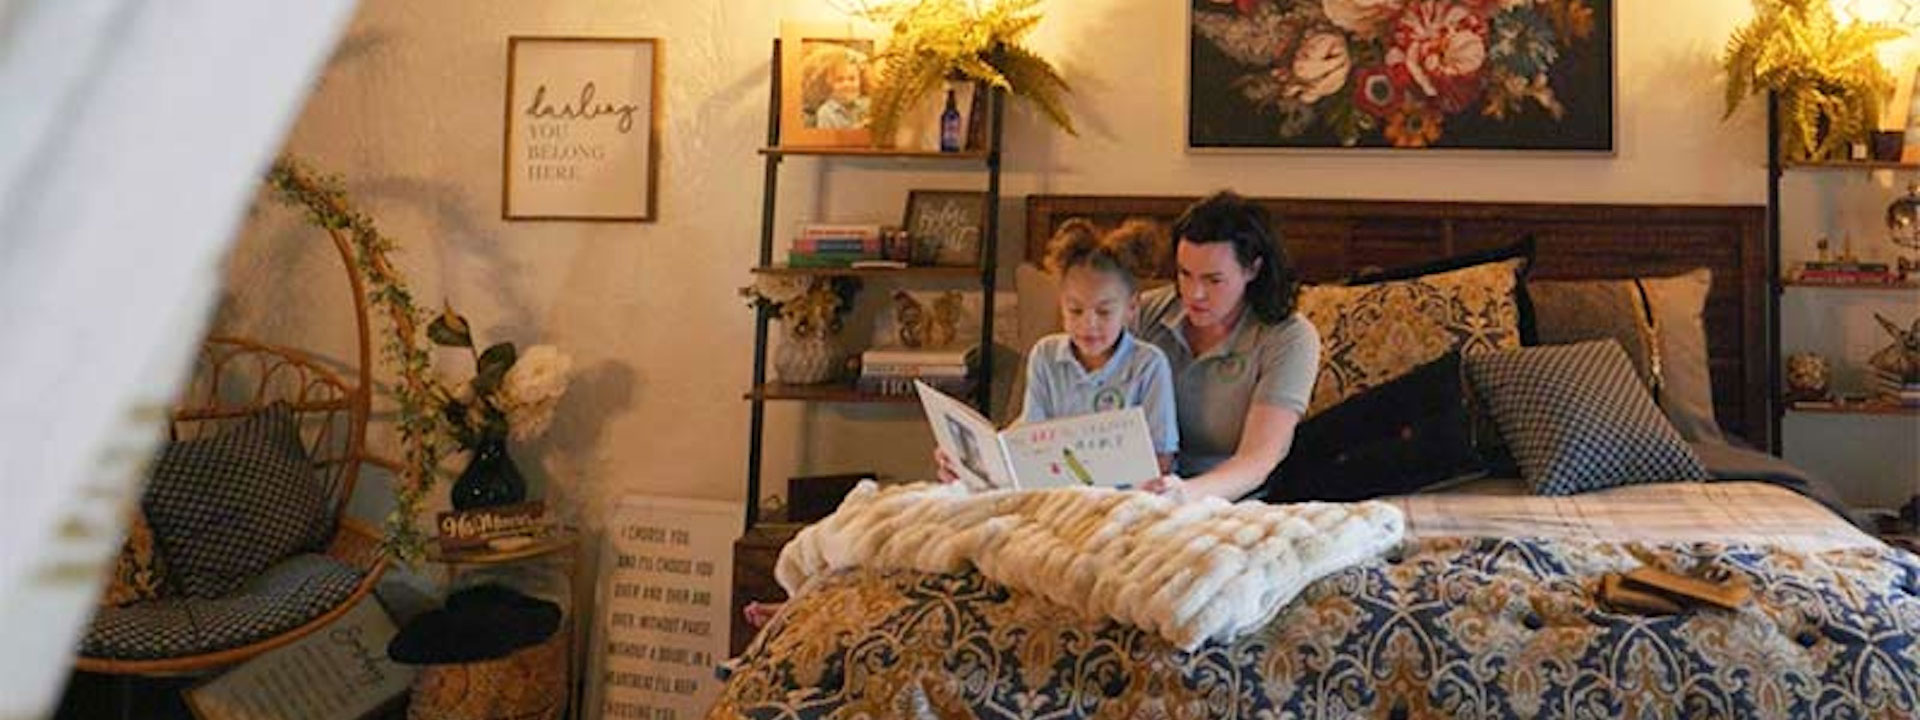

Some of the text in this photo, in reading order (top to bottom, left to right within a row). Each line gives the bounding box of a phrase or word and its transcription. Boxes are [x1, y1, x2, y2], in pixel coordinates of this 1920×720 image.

[526, 81, 638, 134] darling
[528, 124, 570, 139] YOU
[527, 145, 606, 160] BELONG
[628, 526, 666, 544] CHOOSE
[617, 554, 636, 569] AND
[656, 557, 692, 575] CHOOSE
[696, 561, 714, 577] YOU
[614, 583, 711, 606] OVER AND OVER AND
[640, 615, 679, 632] WITHOUT
[607, 642, 647, 660] WITHOUT
